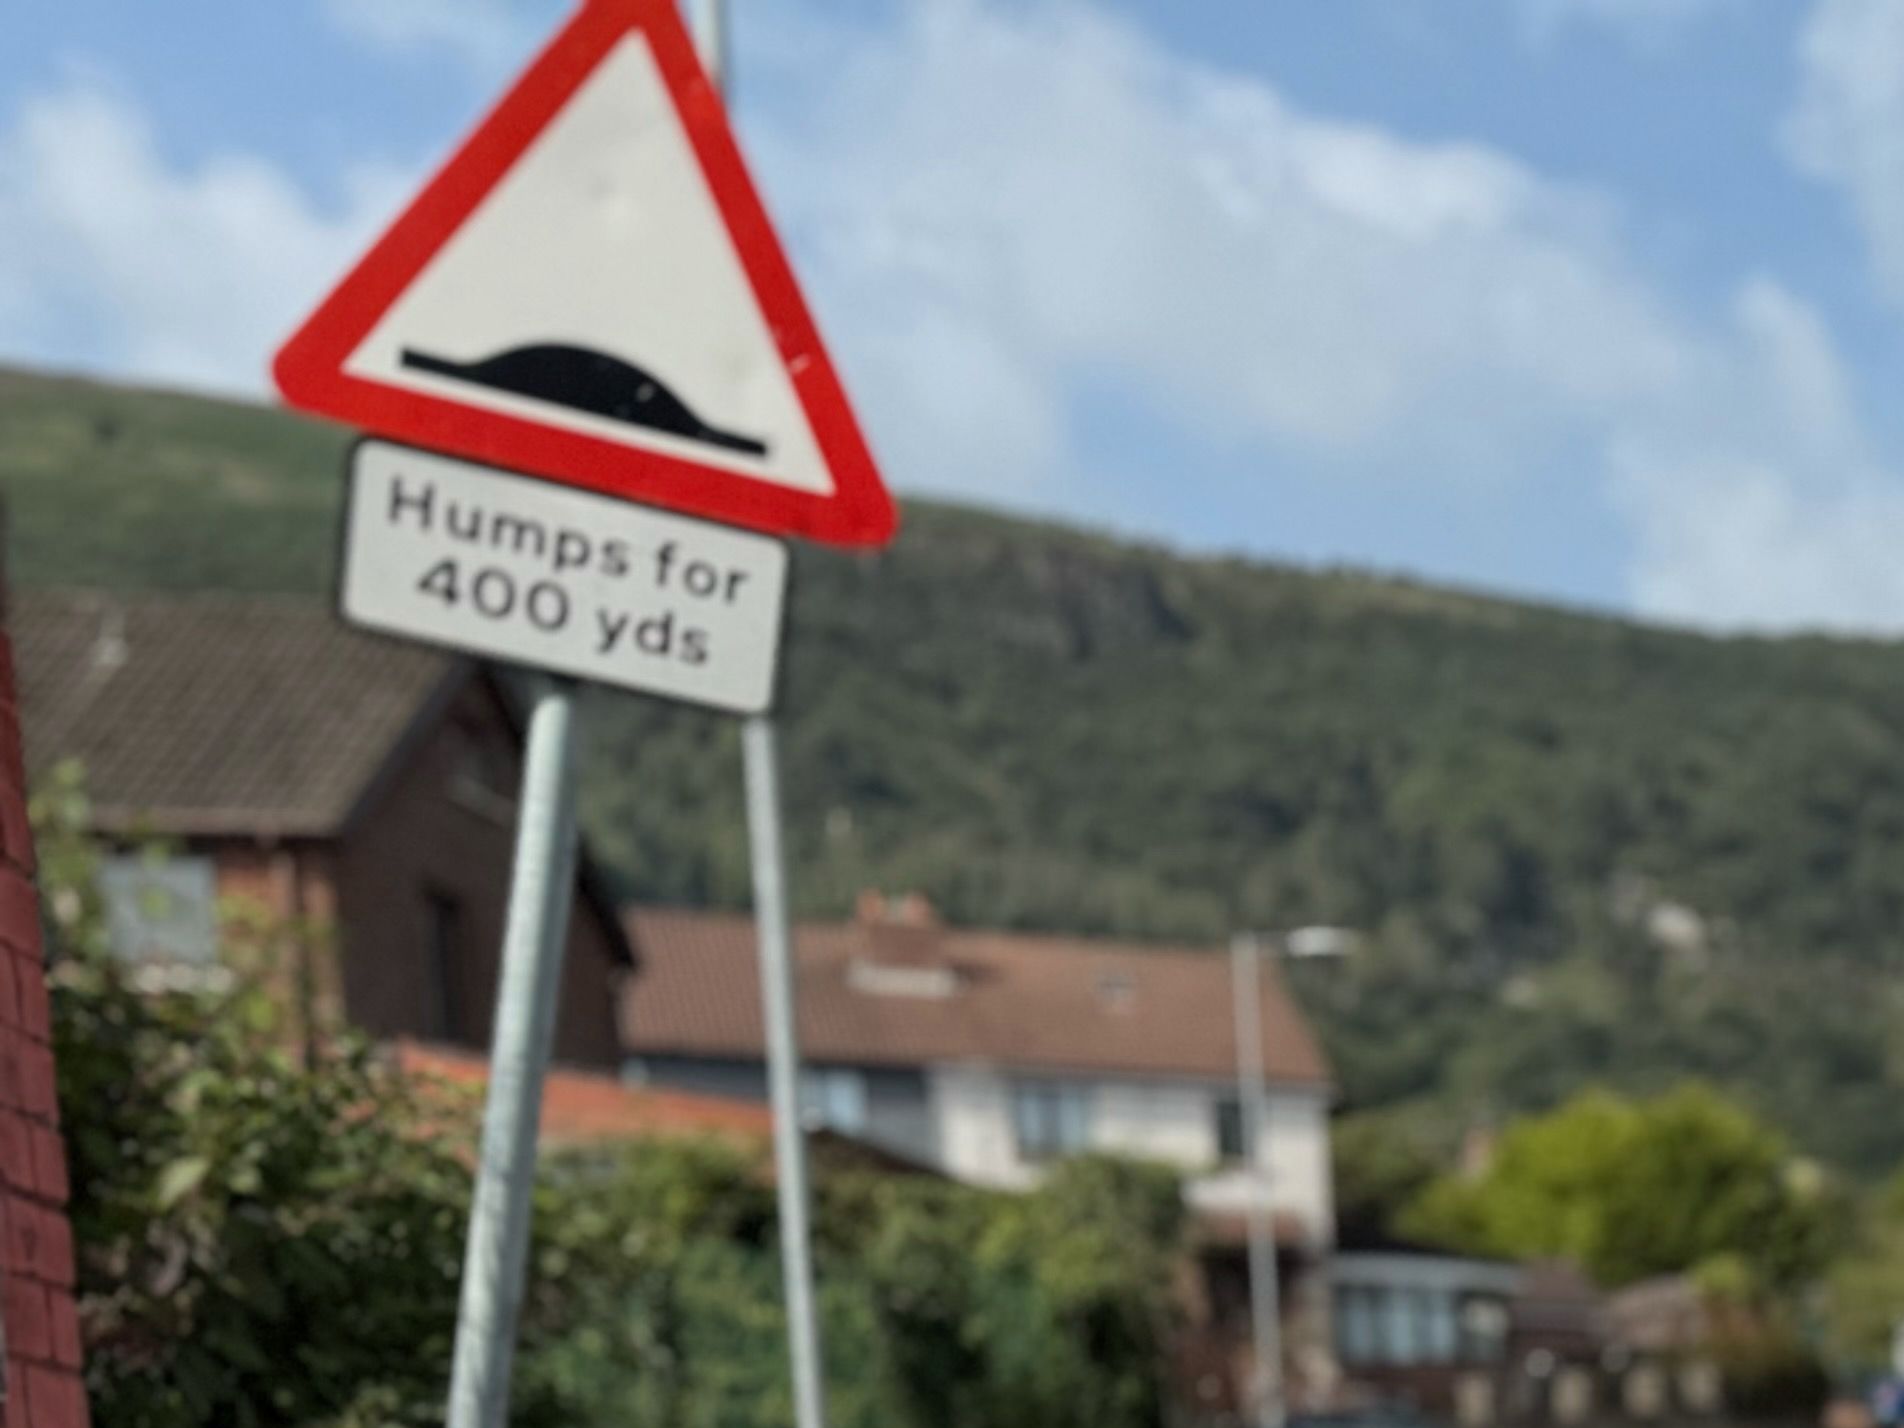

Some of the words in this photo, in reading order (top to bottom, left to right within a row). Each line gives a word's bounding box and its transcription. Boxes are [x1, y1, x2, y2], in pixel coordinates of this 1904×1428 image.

[389, 475, 630, 579] Humps
[656, 540, 750, 604] for
[417, 557, 571, 632] 400
[595, 609, 710, 666] yds
